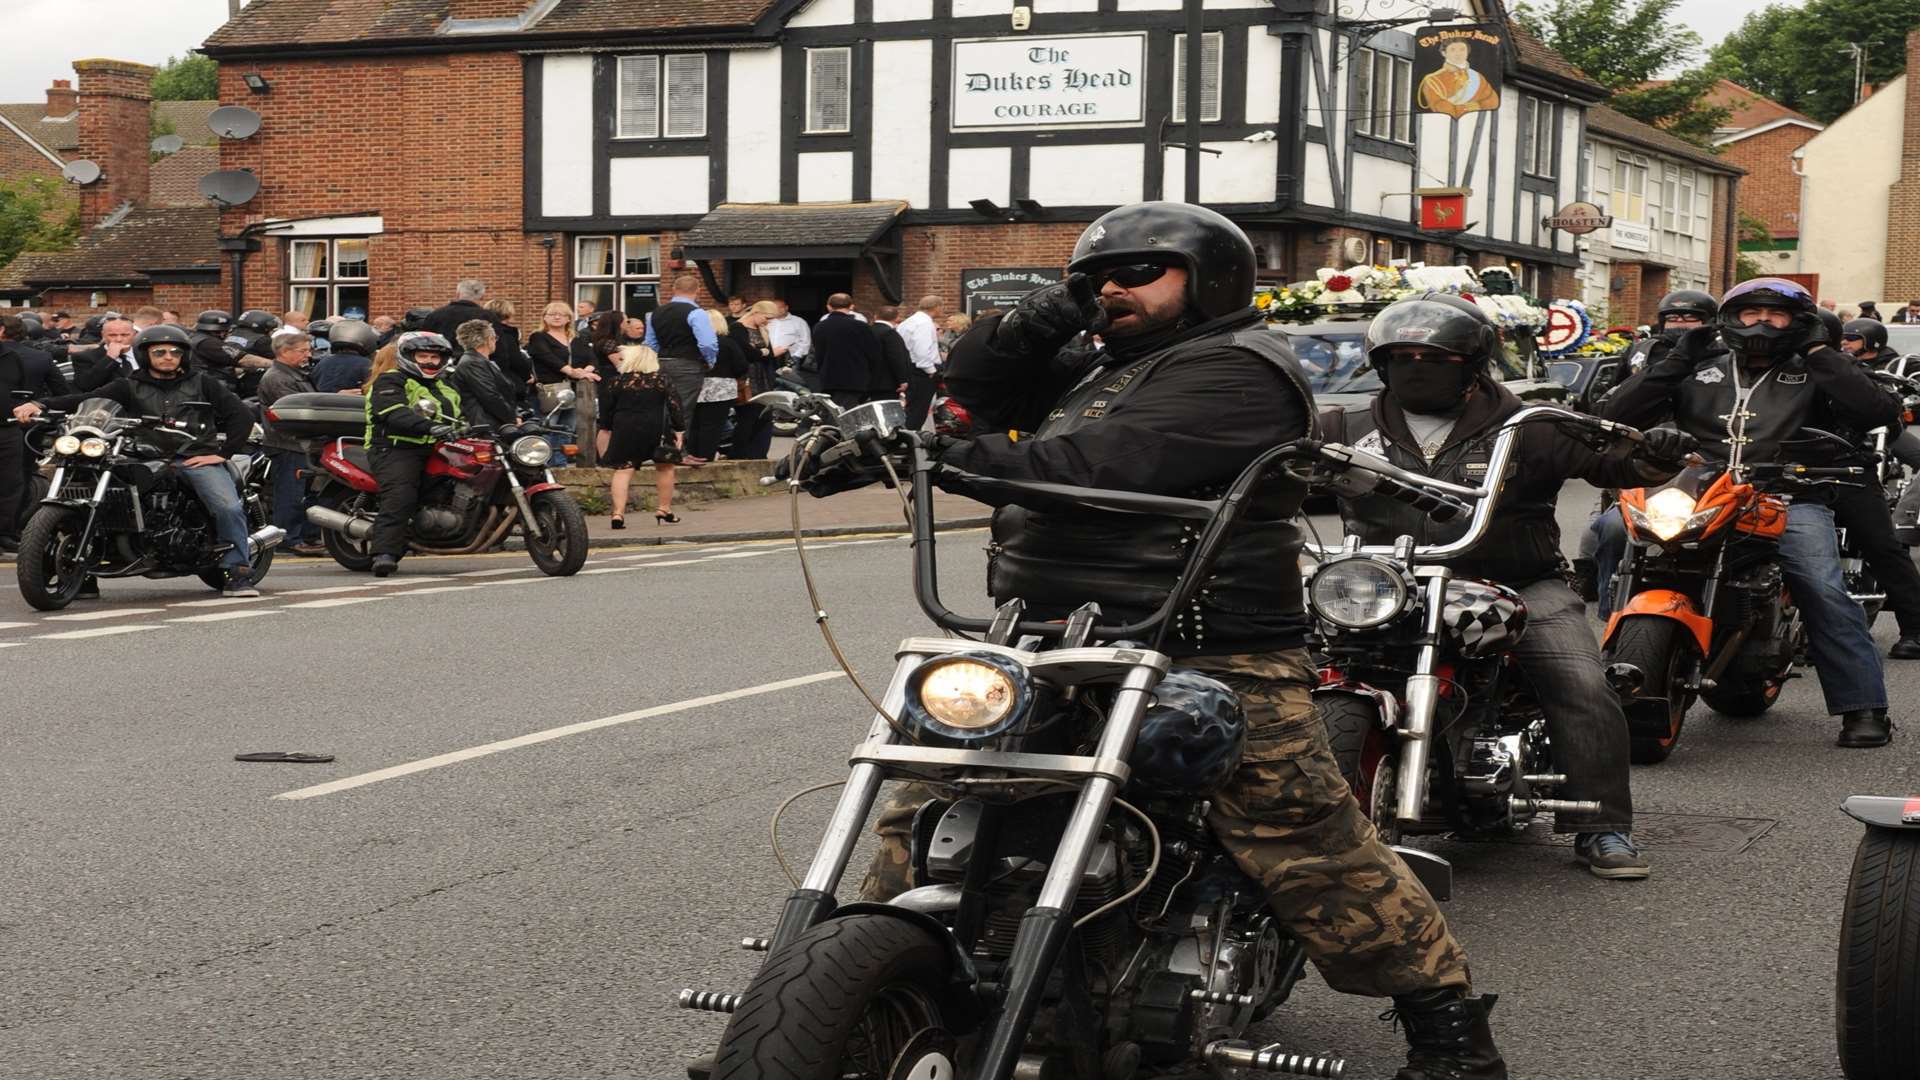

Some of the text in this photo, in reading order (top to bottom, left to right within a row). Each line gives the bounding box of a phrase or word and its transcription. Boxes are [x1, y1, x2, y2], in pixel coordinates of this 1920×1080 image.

[1028, 47, 1070, 64] The
[965, 68, 1132, 92] Dukes Head
[994, 103, 1097, 118] COURAGE
[1552, 217, 1607, 227] HOLSTEN
[966, 277, 989, 289] The
[990, 272, 1028, 282] Dukes
